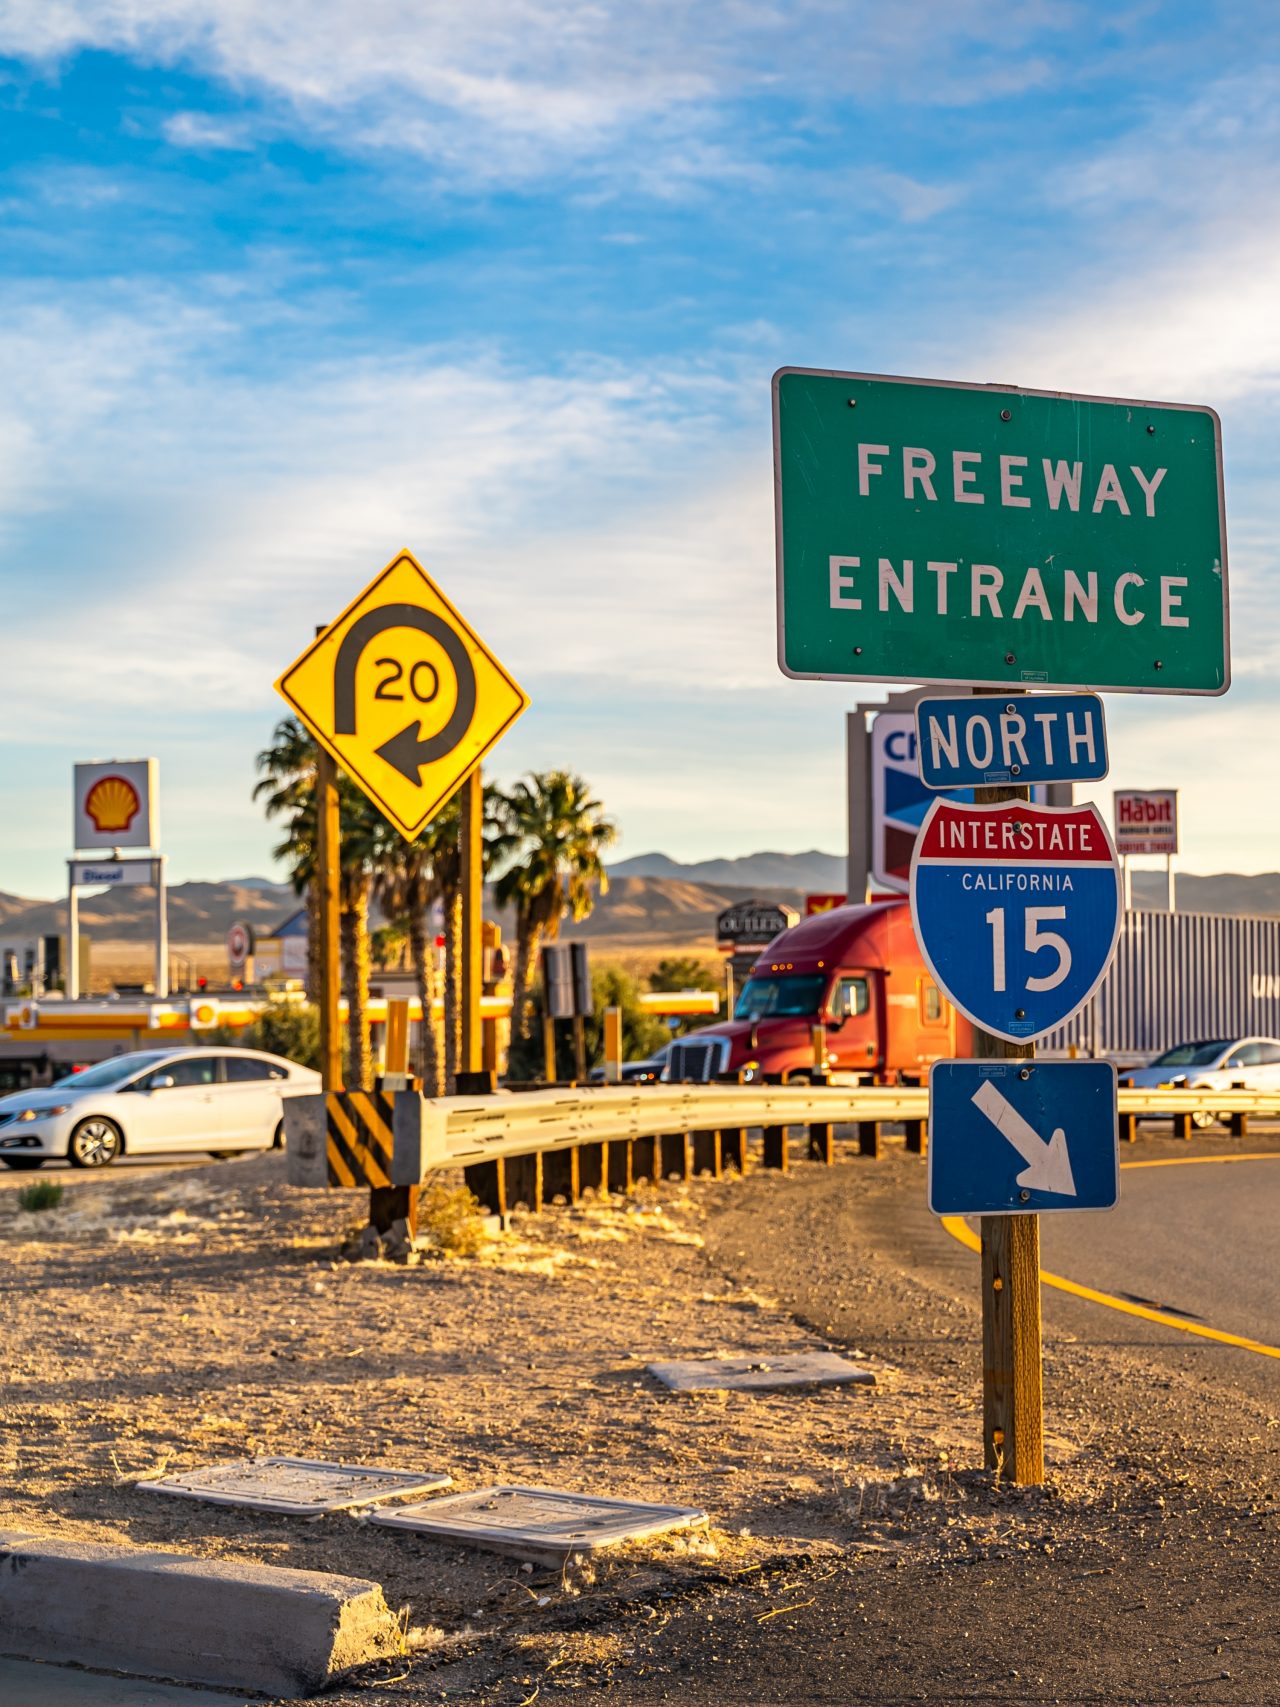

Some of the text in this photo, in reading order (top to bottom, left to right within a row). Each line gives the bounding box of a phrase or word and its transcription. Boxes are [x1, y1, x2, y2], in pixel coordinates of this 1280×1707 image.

[857, 442, 1168, 518] FREEWAY
[828, 554, 1190, 629] ENTRANCE
[374, 657, 440, 703] 20
[927, 710, 1098, 770] NORTH
[938, 820, 1093, 852] INTERSTATE
[1119, 798, 1172, 822] Habit
[961, 872, 1074, 892] CALIFORNIA
[985, 905, 1073, 993] 15
